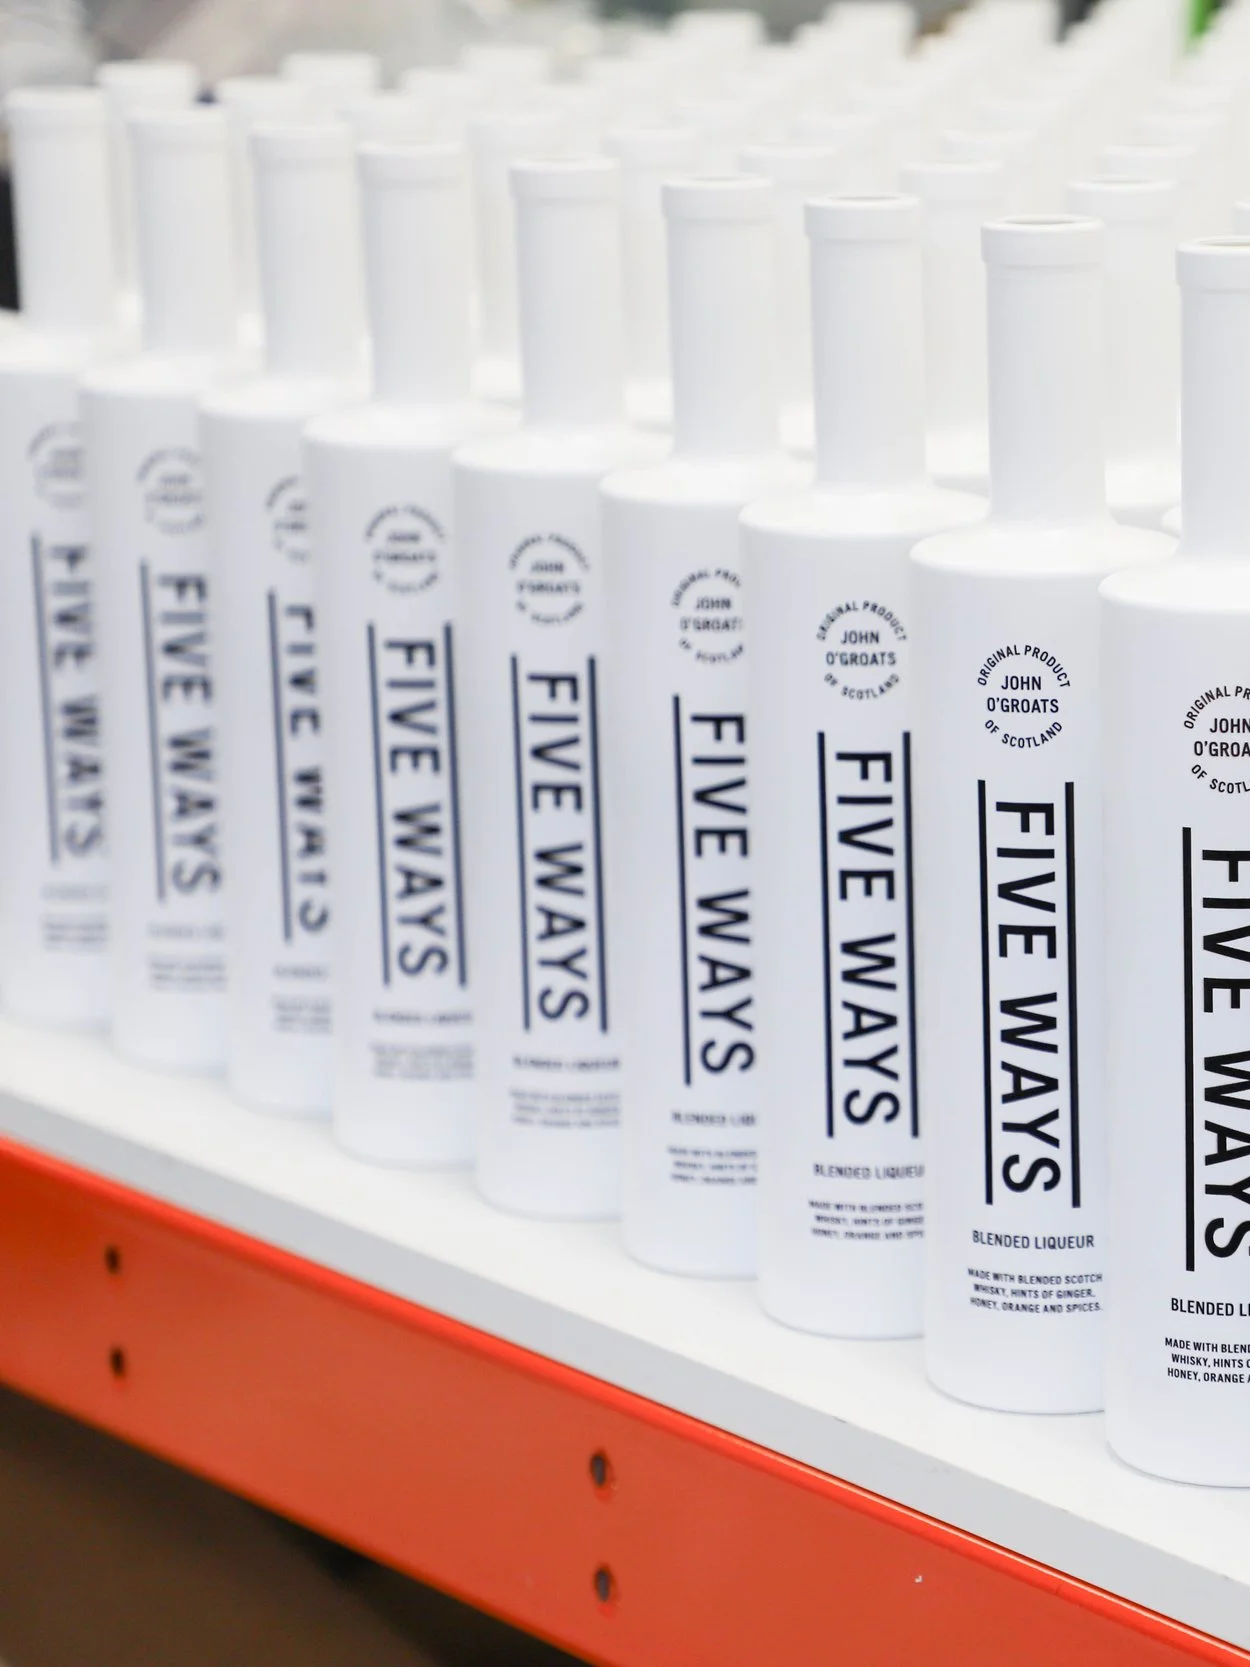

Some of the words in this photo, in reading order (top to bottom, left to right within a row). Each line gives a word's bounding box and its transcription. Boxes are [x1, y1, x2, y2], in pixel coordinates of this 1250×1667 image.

[680, 616, 743, 632] O'GROAT
[862, 600, 907, 641] PRODUCT
[157, 574, 213, 701] FIVE
[840, 630, 880, 645] JOHN
[826, 651, 896, 666] O'GROATS
[977, 644, 1021, 686] ORIGINAL
[1023, 644, 1071, 688] PRODUCT
[1001, 675, 1042, 690] JOHN
[384, 638, 441, 775] FIVE
[987, 697, 1059, 713] O'GROATS
[1184, 685, 1231, 729] ORIGINAL
[527, 672, 583, 813] FIVE
[985, 719, 1000, 734] OF
[1001, 721, 1063, 748] SCOTLAND
[690, 714, 748, 858] FIVE
[1191, 764, 1208, 779] OF
[167, 726, 221, 893] WAYS
[836, 752, 895, 901] FIVE
[392, 801, 449, 975] WAYS
[995, 801, 1057, 959] FIVE
[533, 842, 590, 1020] WAYS
[696, 889, 755, 1076] WAYS
[840, 933, 900, 1125] WAYS
[1000, 991, 1062, 1193] WAYS
[813, 1162, 871, 1179] BLENDED
[875, 1163, 925, 1180] LIQUEU
[972, 1230, 1030, 1249] BLENDED
[1035, 1235, 1095, 1250] LIQUEUR
[968, 1268, 990, 1280] MADE
[993, 1272, 1015, 1283] WITH
[1018, 1275, 1062, 1285] BLENDED
[1064, 1273, 1103, 1285] SCOTCH
[1001, 1302, 1041, 1314] ORANGE
[1043, 1304, 1064, 1314] AND
[1011, 1288, 1039, 1299] HINTS
[1042, 1289, 1054, 1299] OF
[1171, 1297, 1234, 1316] BLENDED
[1165, 1337, 1191, 1350] MADE
[1193, 1341, 1218, 1352] WITH
[1167, 1367, 1201, 1382] HONEY,
[1203, 1372, 1245, 1383] ORANGE
[1171, 1353, 1211, 1368] WHISKY,
[1213, 1358, 1244, 1368] HINTS
